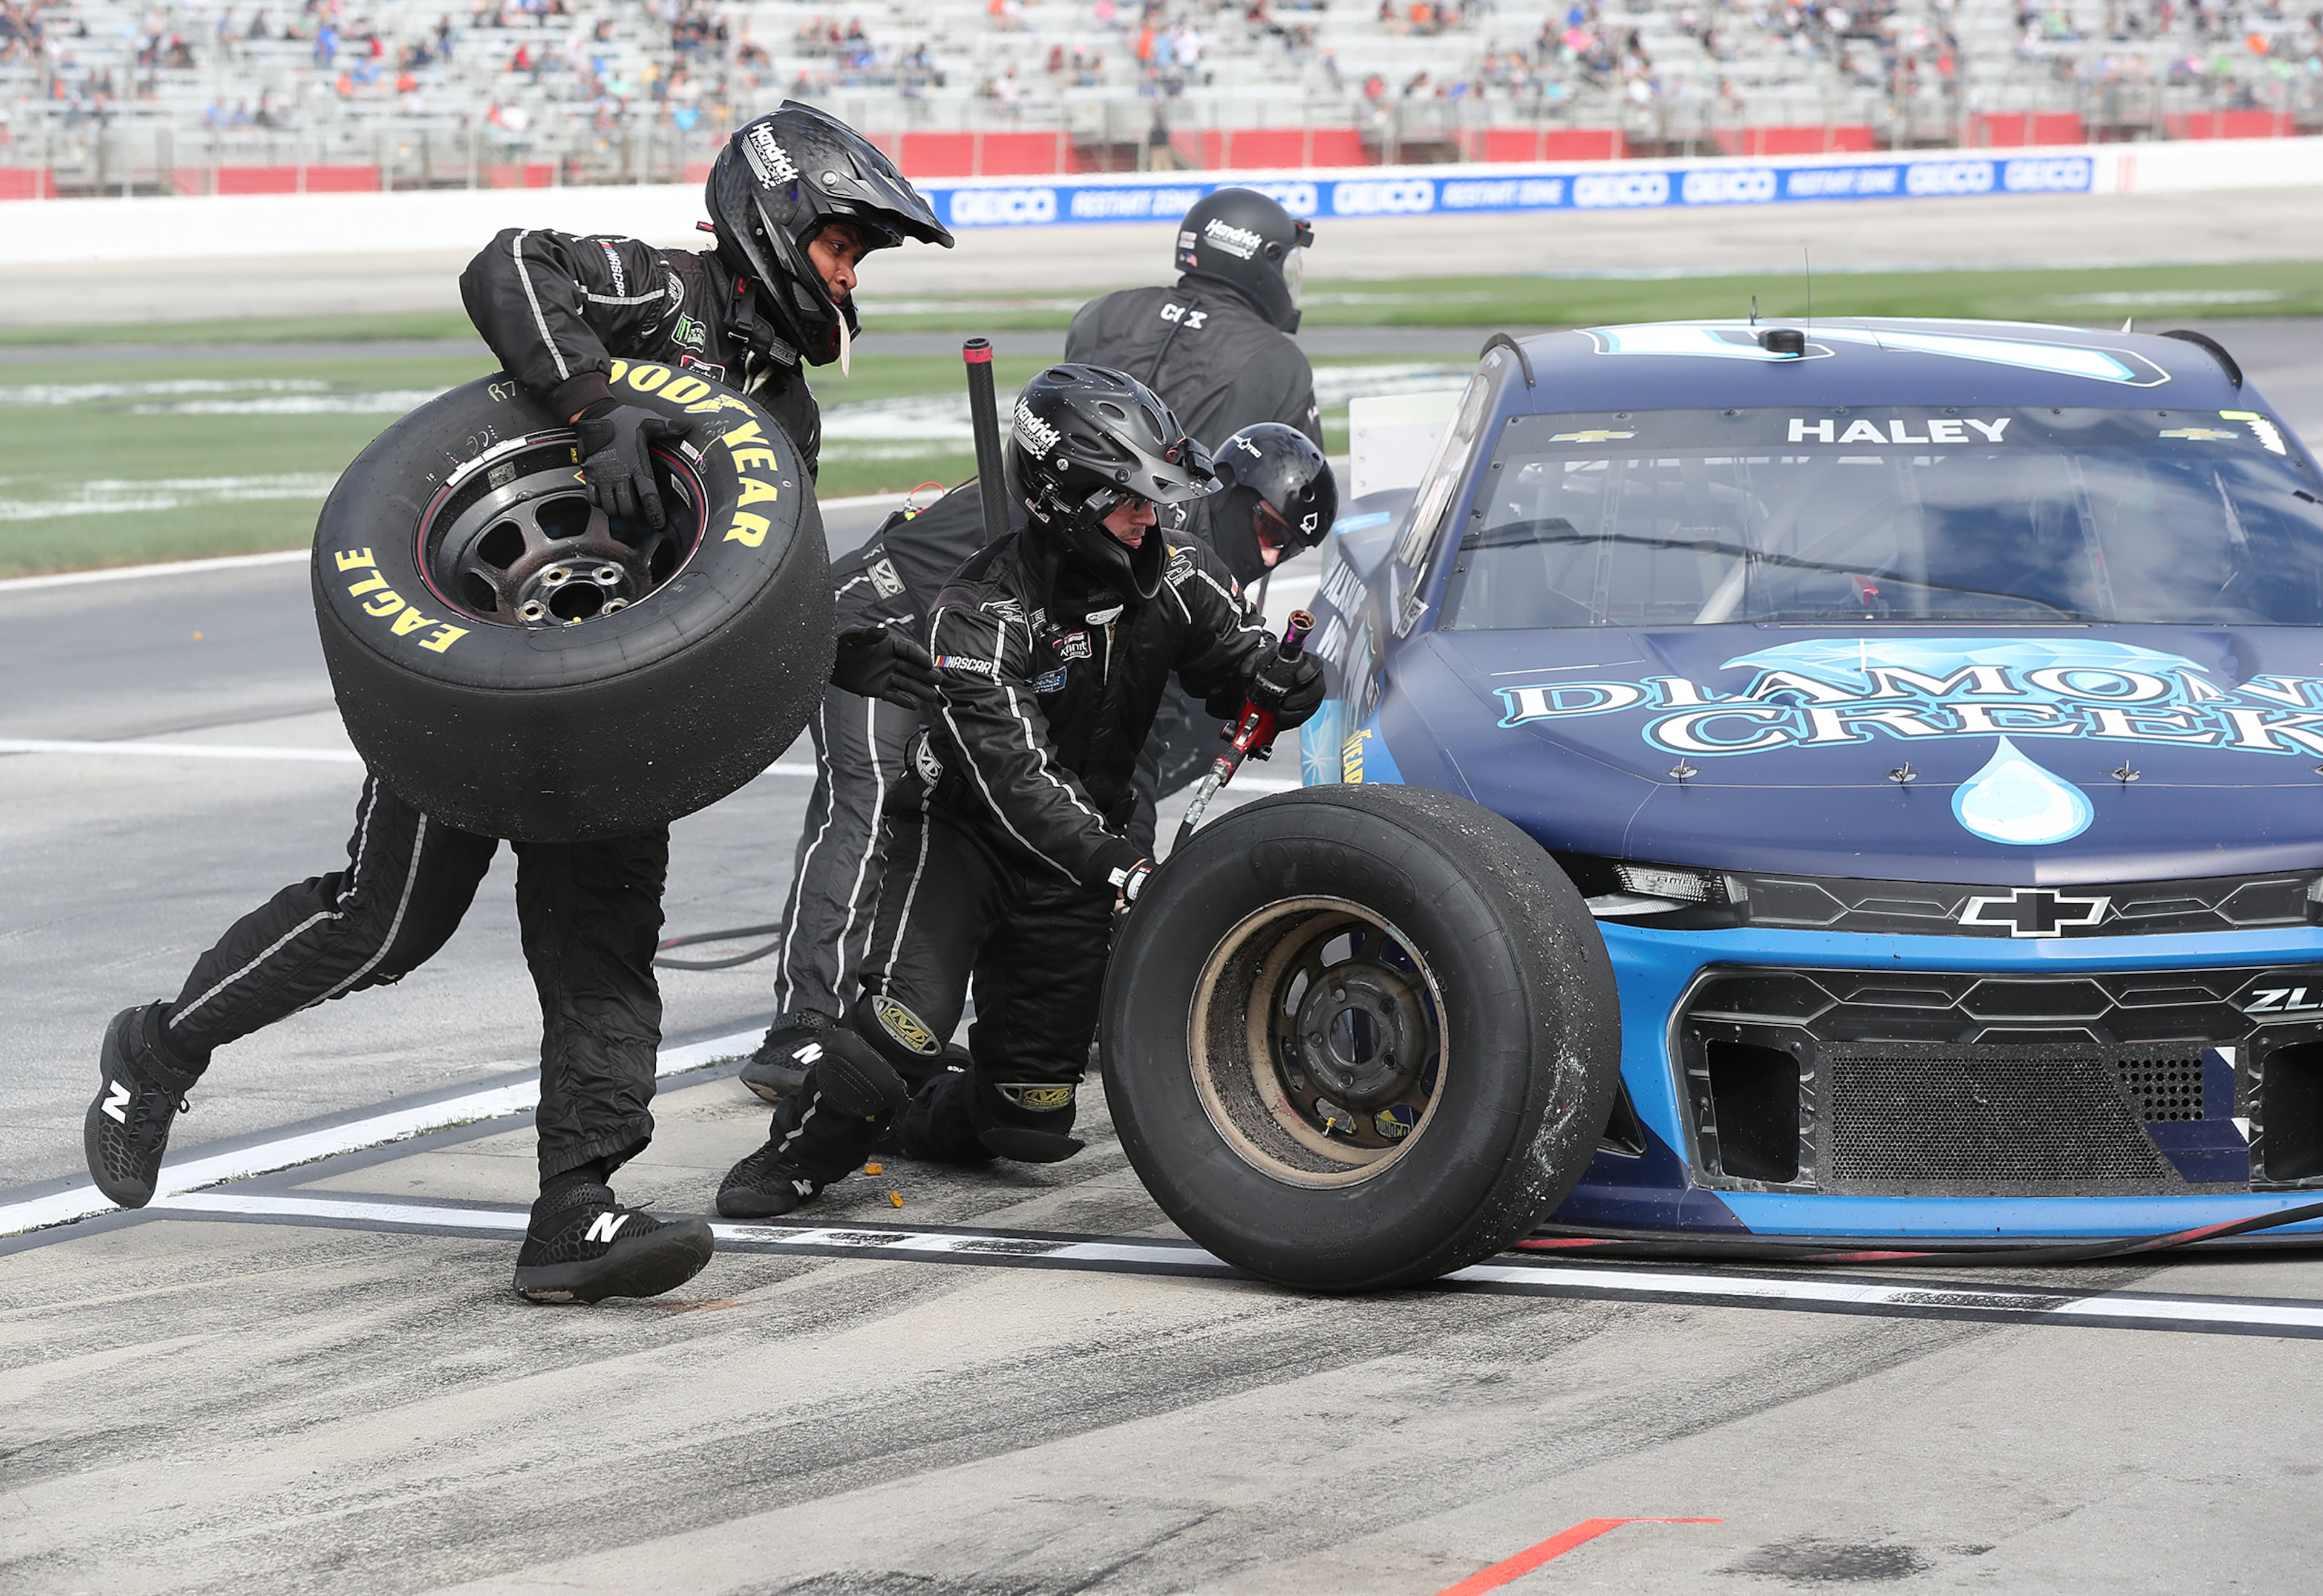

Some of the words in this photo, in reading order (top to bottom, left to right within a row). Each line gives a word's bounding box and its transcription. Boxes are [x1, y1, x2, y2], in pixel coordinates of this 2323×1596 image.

[749, 121, 799, 182] Hendrick
[750, 137, 783, 185] MOTORSPORTS
[1573, 173, 1670, 208] GEICO
[1682, 170, 1777, 204] GEICO
[1906, 162, 1994, 194] GEICO
[2004, 159, 2089, 191] GEICO
[950, 189, 1057, 224] GEICO
[1333, 180, 1434, 215] GEICO
[1204, 218, 1263, 249] Hendrick
[606, 251, 626, 297] NASCAR
[1014, 396, 1062, 448] Hendrick
[1015, 417, 1050, 452] MOTORSPORTS
[1787, 418, 2011, 443] HALEY
[609, 359, 779, 548] ODYEAR
[335, 547, 471, 653] EAGLE
[946, 656, 993, 675] NASCAR
[1653, 703, 2323, 755] CREEK
[2243, 987, 2323, 1013] ZL
